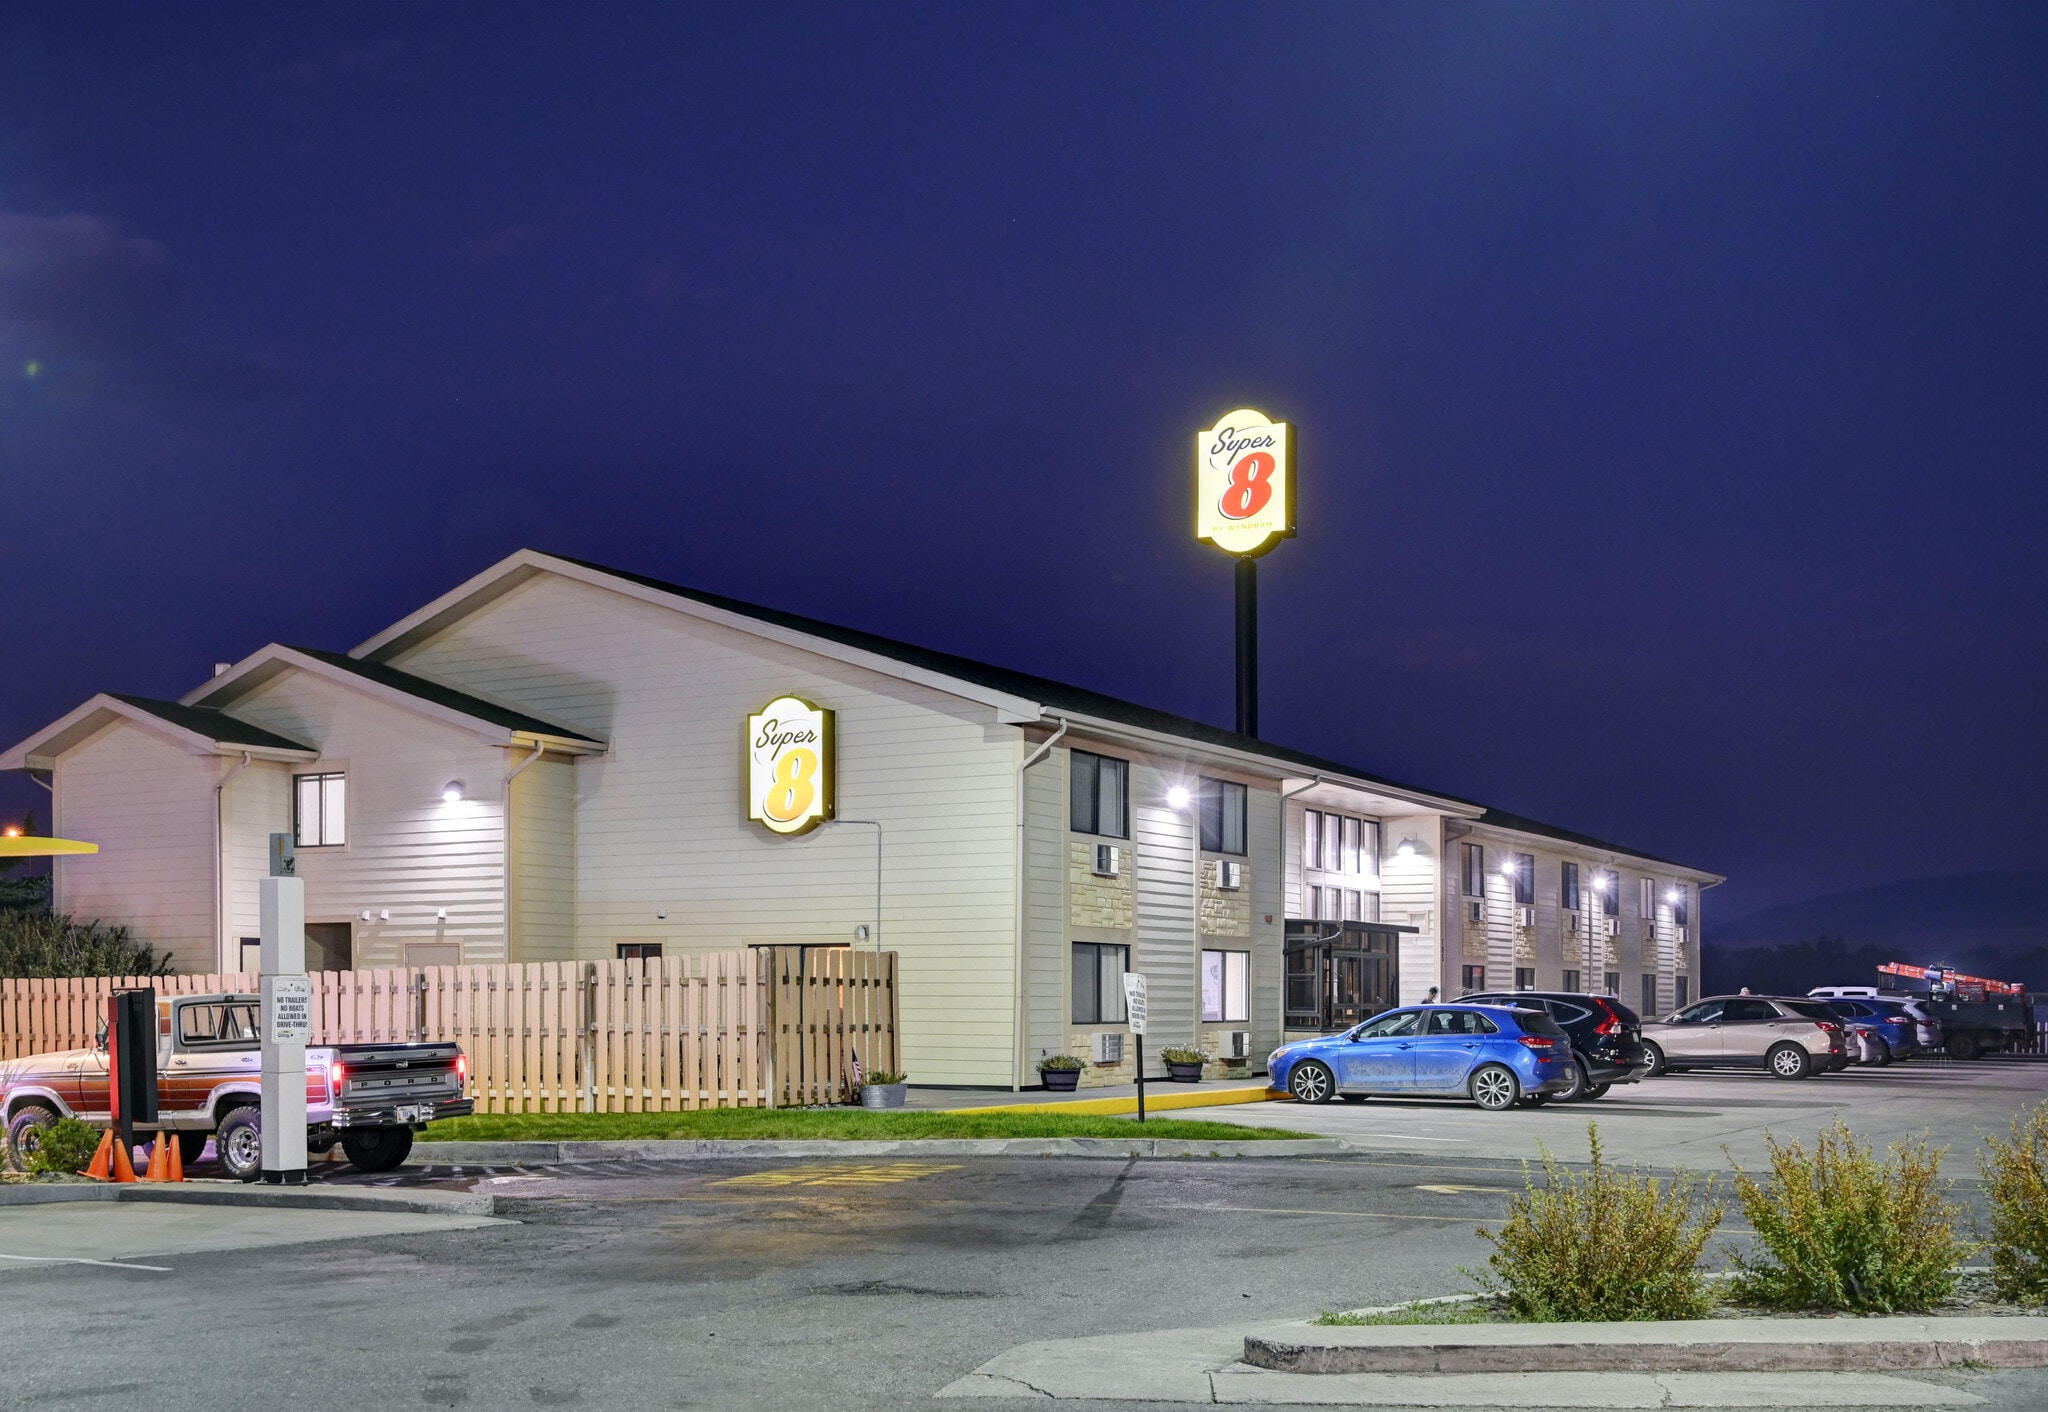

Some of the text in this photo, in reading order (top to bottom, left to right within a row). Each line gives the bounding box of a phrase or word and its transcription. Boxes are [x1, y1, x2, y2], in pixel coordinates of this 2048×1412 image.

[1211, 426, 1276, 466] Super
[1219, 451, 1276, 519] 8
[755, 718, 818, 761] Super
[765, 747, 818, 820] 8
[277, 996, 284, 1004] NO
[361, 1077, 438, 1087] FORD
